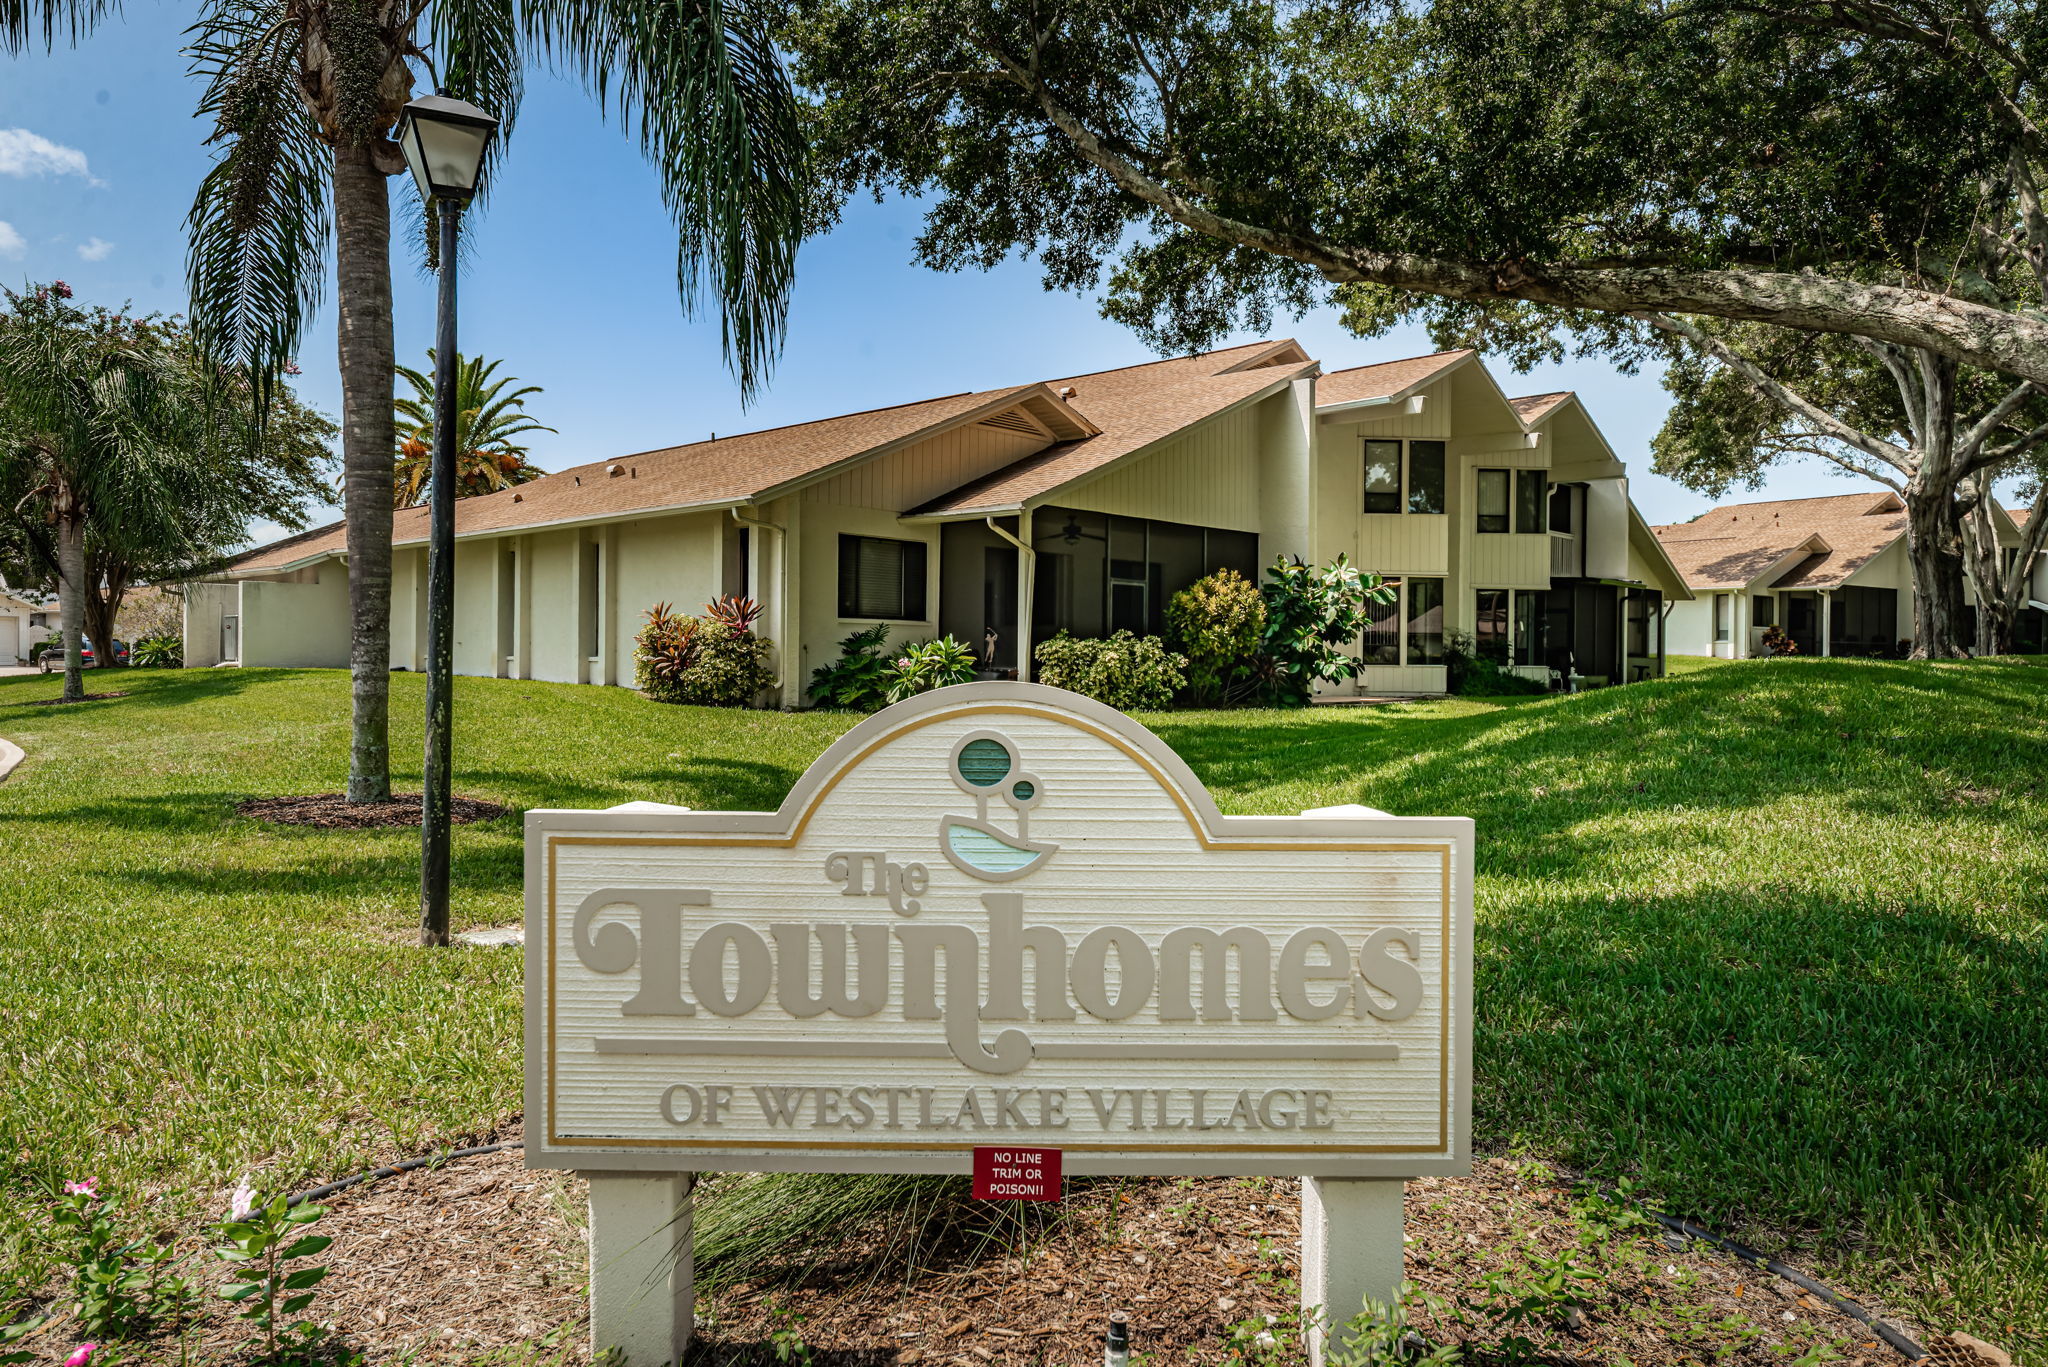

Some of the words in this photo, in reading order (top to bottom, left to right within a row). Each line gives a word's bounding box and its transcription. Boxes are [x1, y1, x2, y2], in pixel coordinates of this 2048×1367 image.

[825, 851, 930, 917] The
[573, 887, 1424, 1074] Townhomes
[660, 1083, 734, 1125] OF
[752, 1085, 1071, 1129] WESTLAKE
[1085, 1088, 1335, 1131] VILLAGE
[992, 1168, 1022, 1179] TRIM
[1025, 1169, 1043, 1180] OR
[994, 1152, 1012, 1163] NO
[1015, 1153, 1042, 1164] LINE
